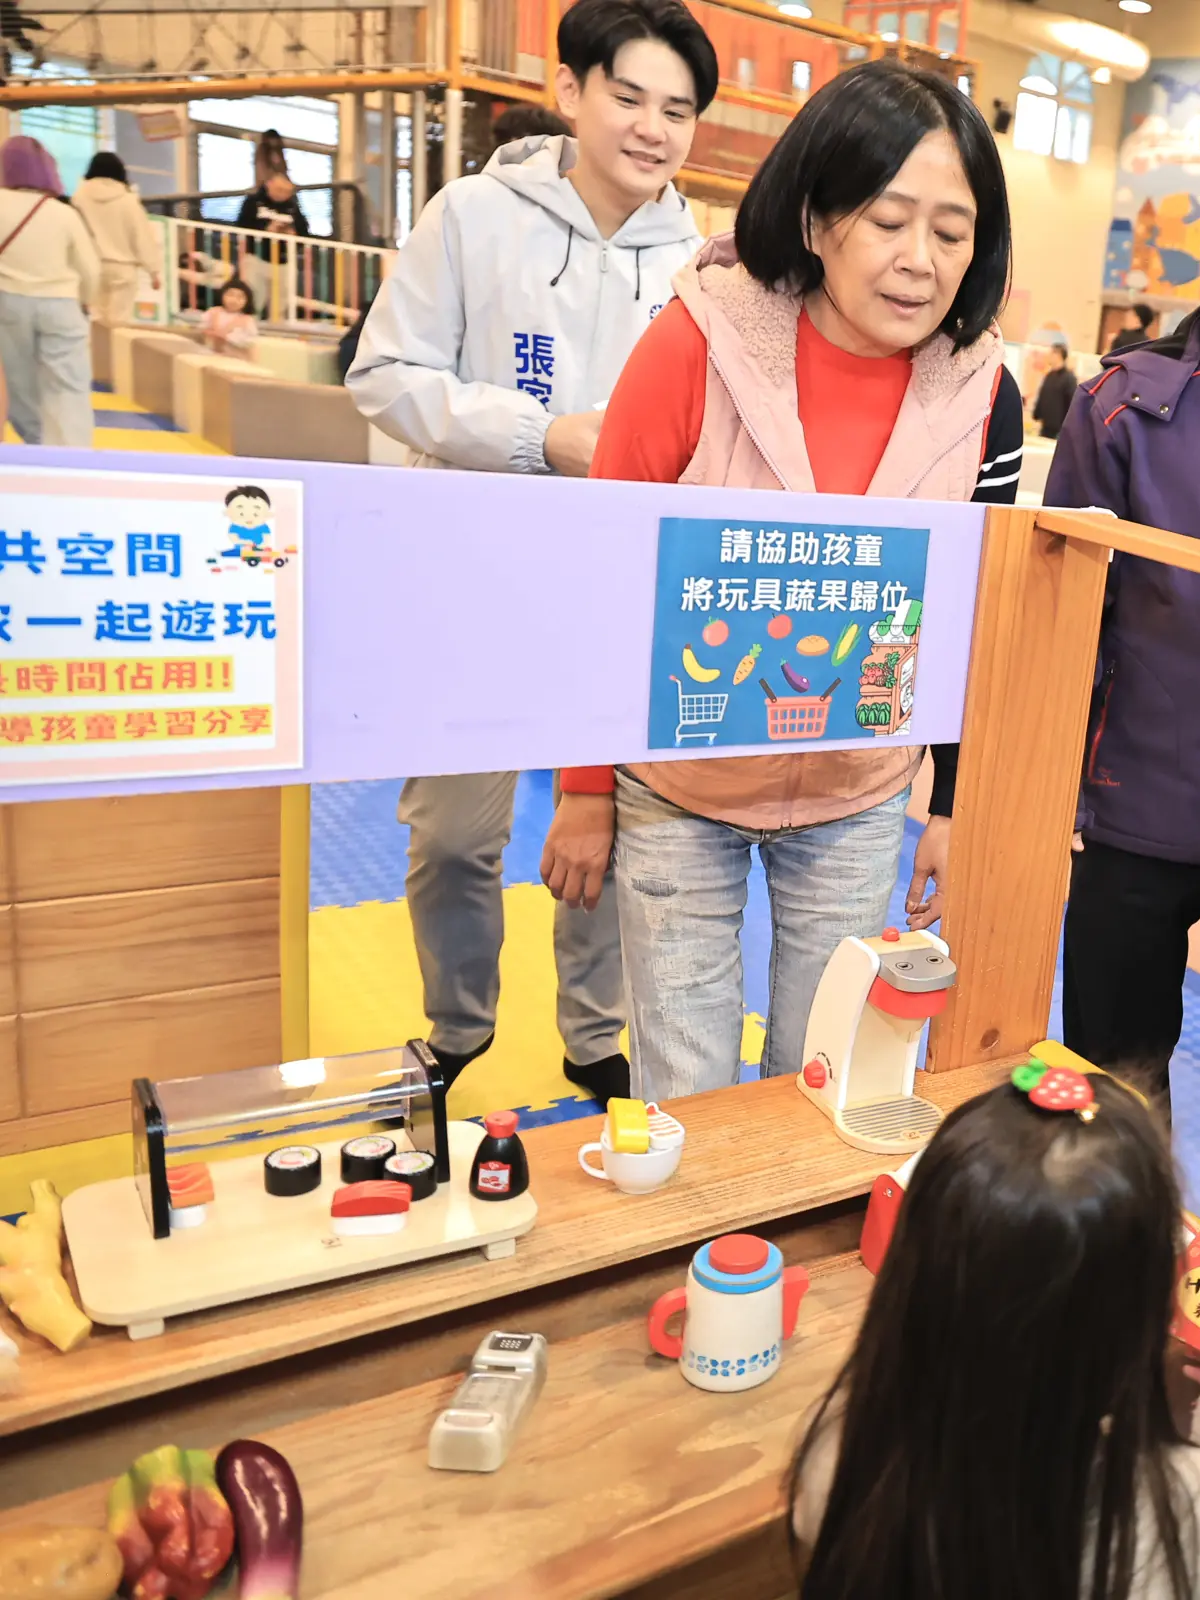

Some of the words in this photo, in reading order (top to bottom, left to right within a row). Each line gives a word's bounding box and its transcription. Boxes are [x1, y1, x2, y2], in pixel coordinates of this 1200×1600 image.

[720, 528, 883, 567] 請協助孩童
[681, 577, 908, 612] 將玩具蔬果歸位
[0, 600, 276, 643] 一起遊玩
